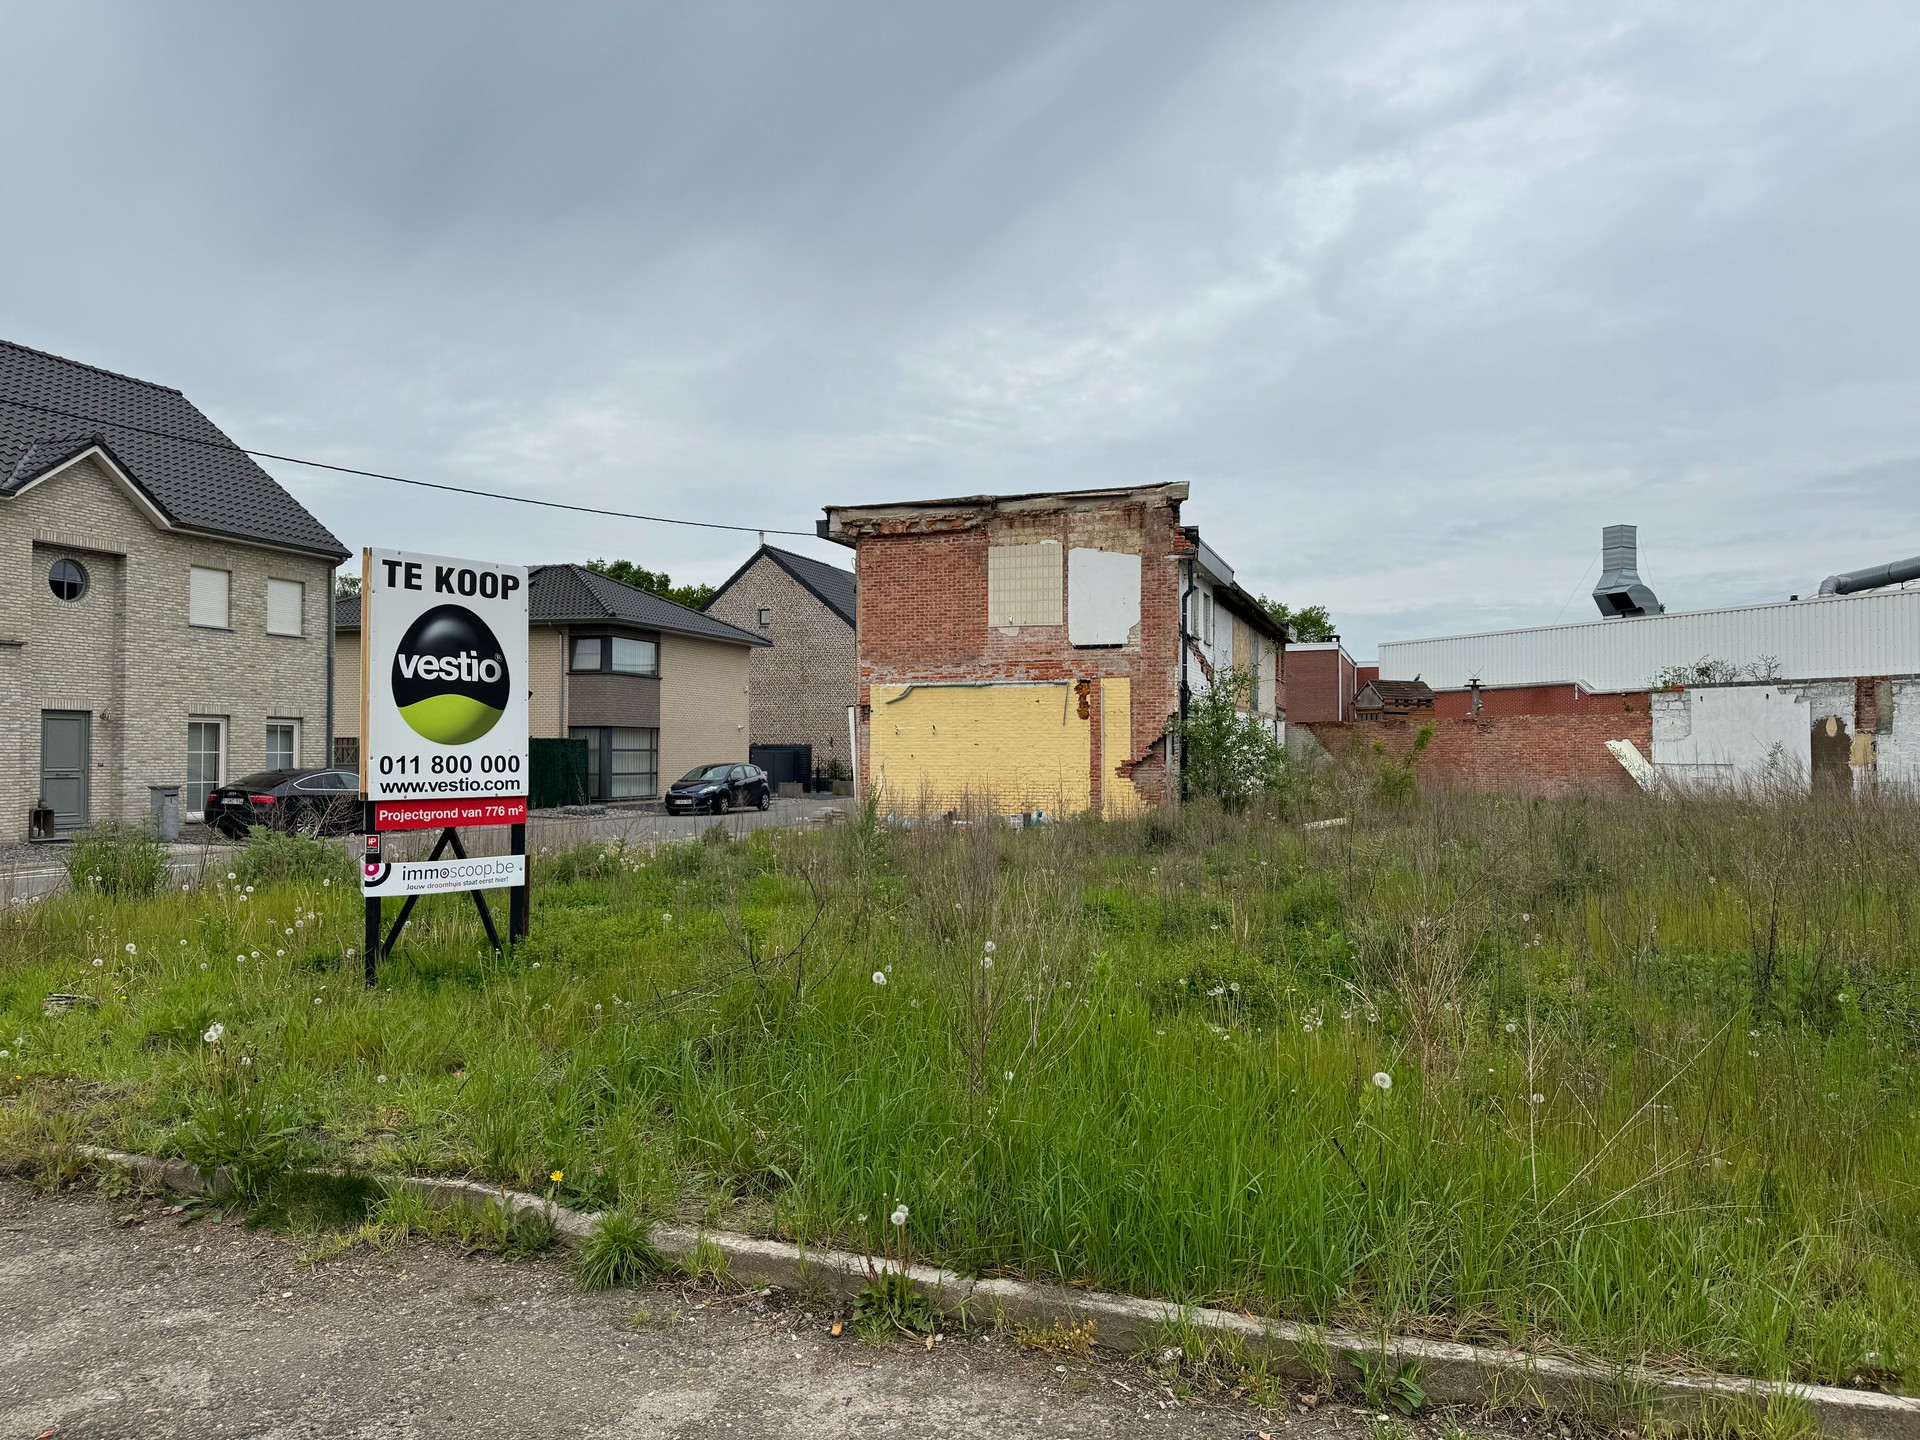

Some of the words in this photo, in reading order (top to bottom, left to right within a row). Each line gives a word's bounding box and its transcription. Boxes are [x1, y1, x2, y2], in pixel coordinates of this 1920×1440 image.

[382, 559, 422, 591] TE
[435, 566, 520, 600] KOOP
[398, 650, 502, 683] vestio
[380, 755, 420, 775] 011
[431, 755, 472, 774] 800
[480, 755, 520, 773] 000
[380, 777, 520, 793] www.vestio.com
[379, 808, 458, 822] Projectgrond
[461, 809, 482, 818] van
[485, 806, 505, 817] 776
[402, 860, 515, 881] immoscoop.be
[406, 883, 426, 891] Jouw
[427, 880, 462, 890] droomhuis
[463, 879, 478, 887] staat
[478, 877, 494, 885] eerst
